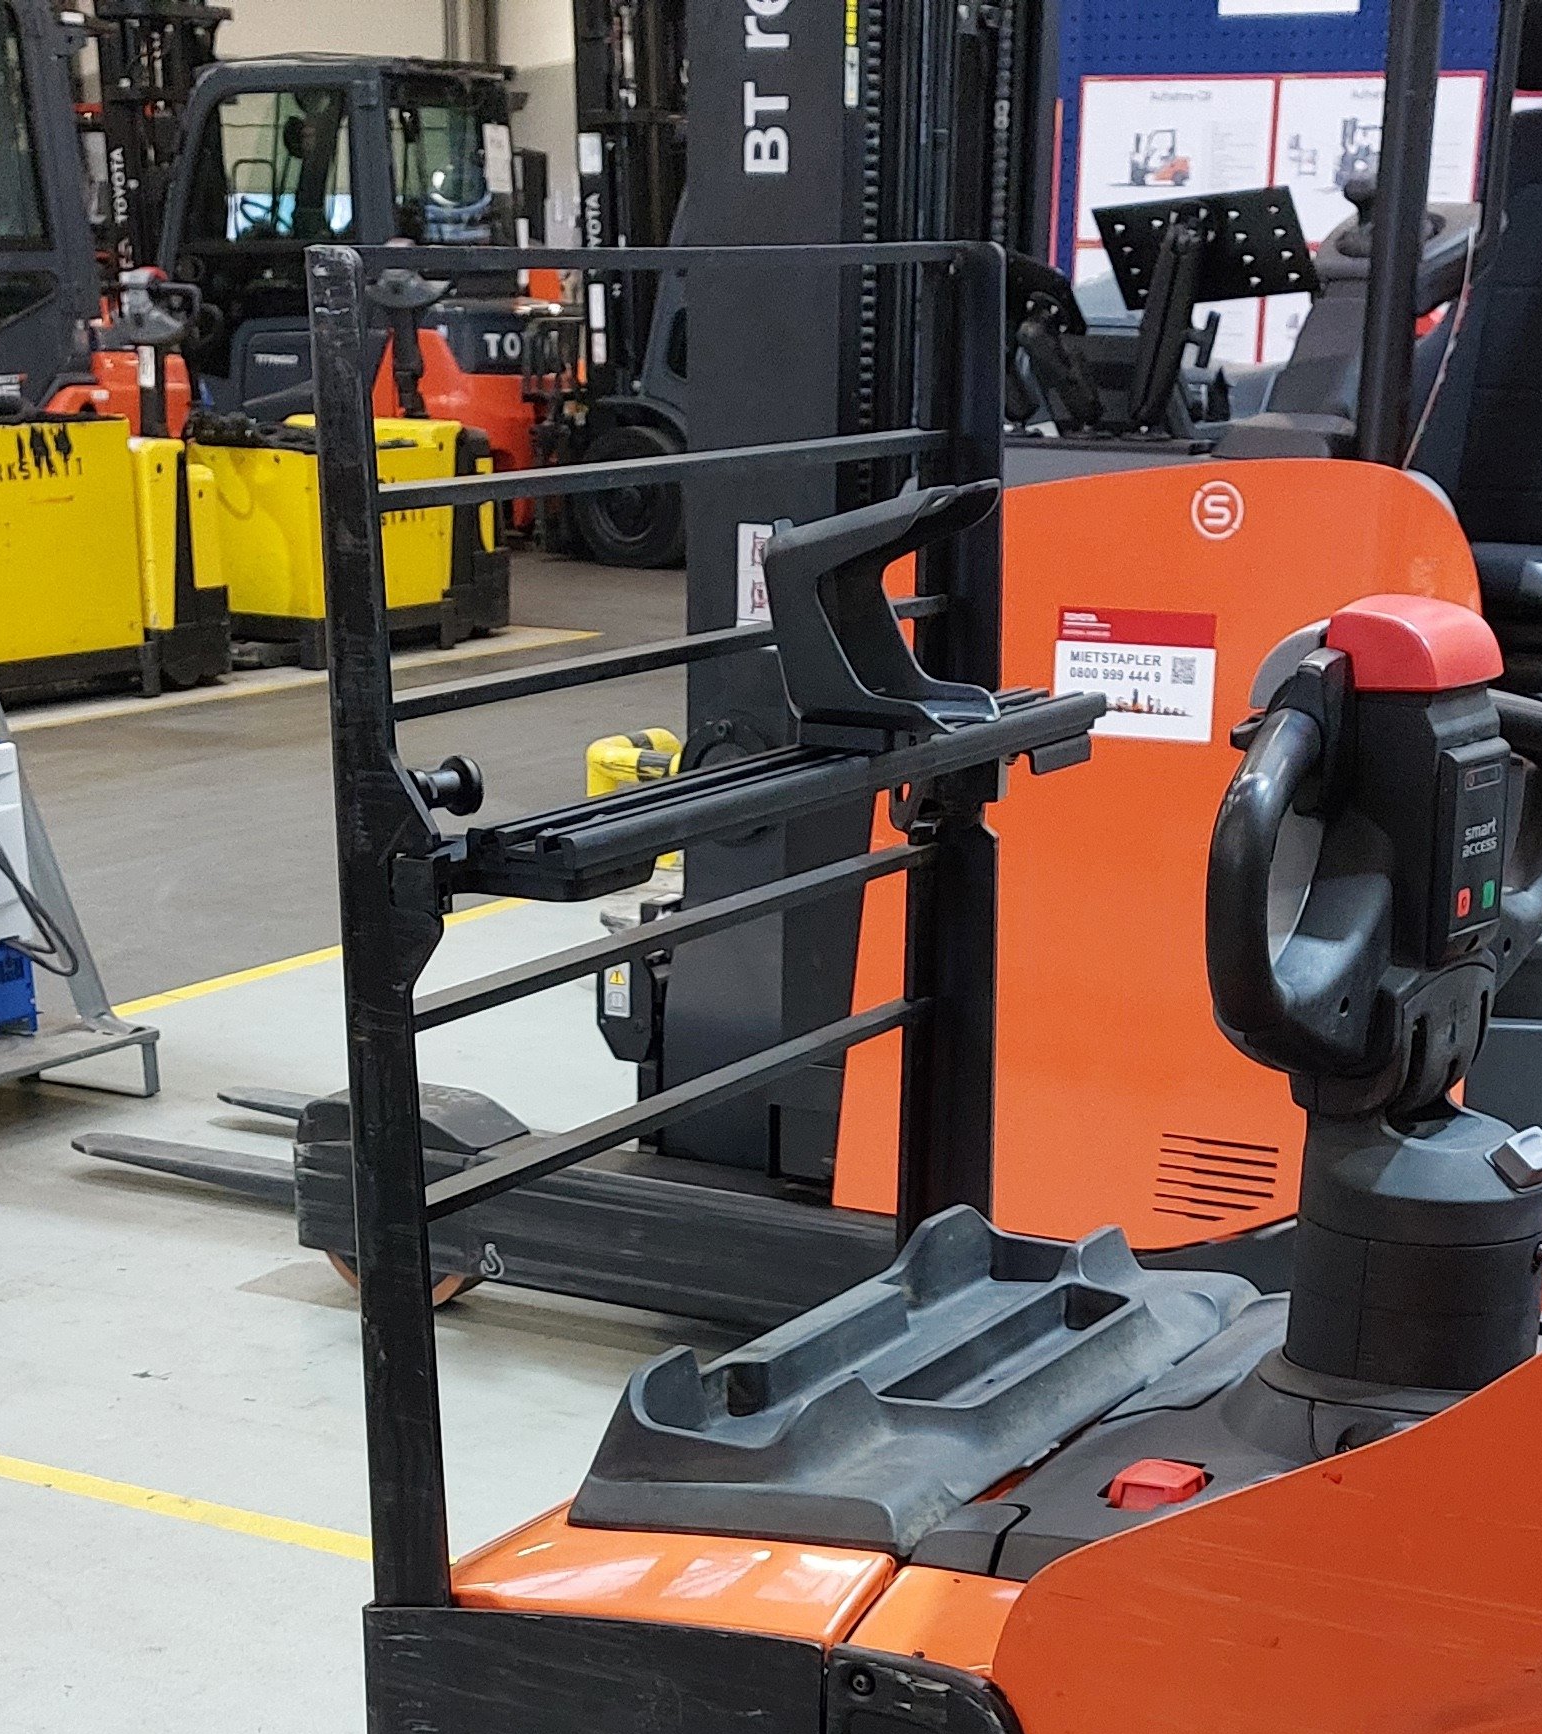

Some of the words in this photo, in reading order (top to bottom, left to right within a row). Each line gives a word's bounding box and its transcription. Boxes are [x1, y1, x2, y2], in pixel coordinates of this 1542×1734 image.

[743, 81, 790, 173] BT
[110, 147, 128, 224] TOYOTA
[1070, 650, 1162, 667] MIETSTAPLER
[1069, 666, 1098, 679] 0800
[1102, 668, 1124, 681] 999
[1128, 670, 1150, 682] 444
[1154, 671, 1162, 683] 9
[1464, 817, 1497, 842] smart
[1462, 836, 1498, 859] access
